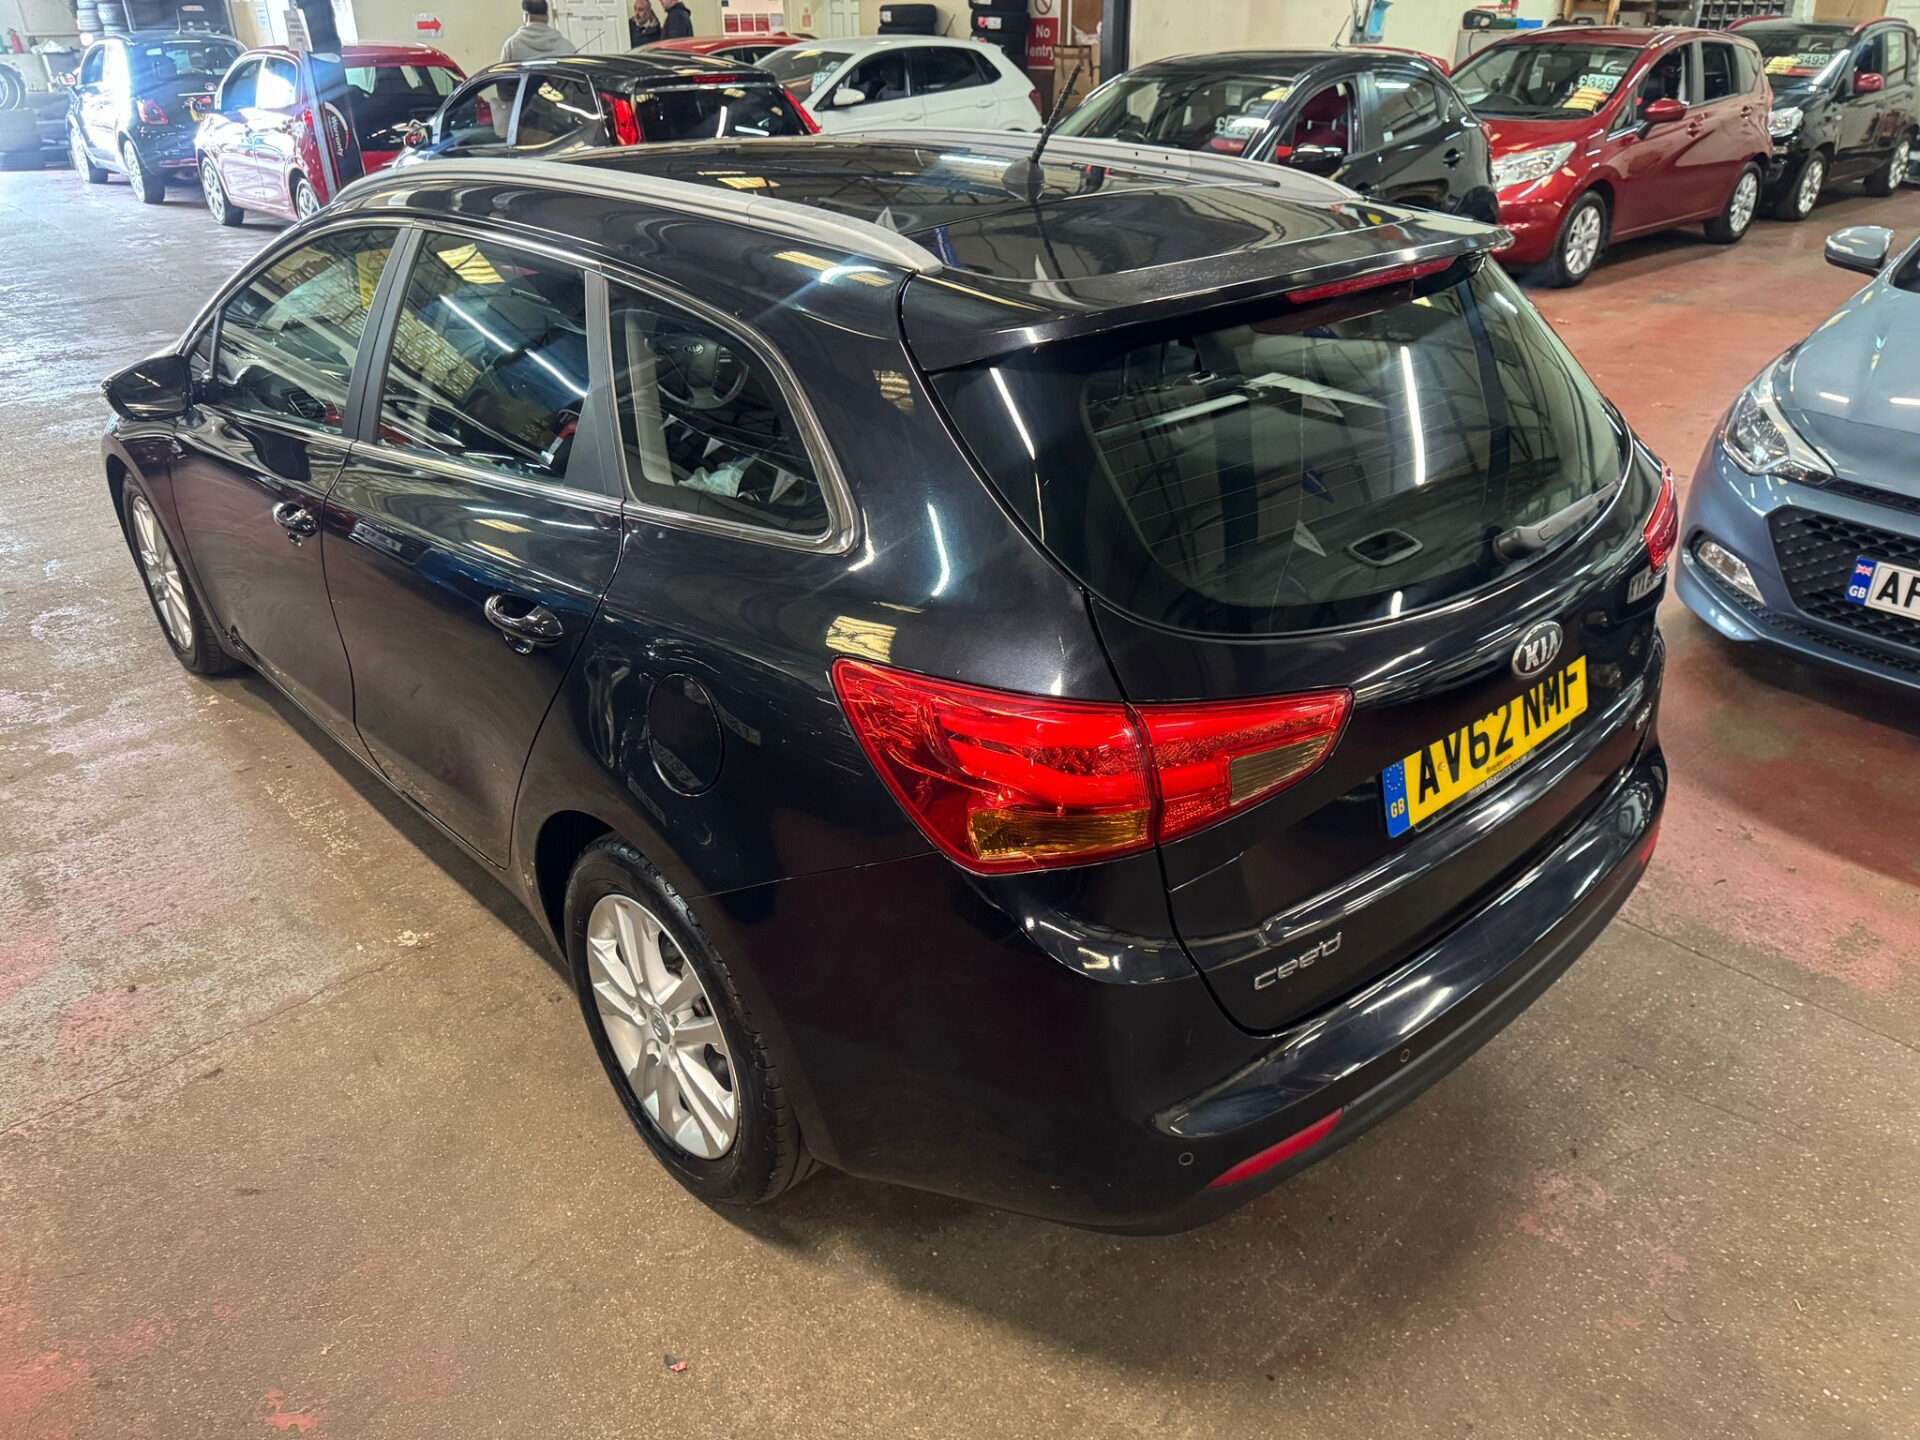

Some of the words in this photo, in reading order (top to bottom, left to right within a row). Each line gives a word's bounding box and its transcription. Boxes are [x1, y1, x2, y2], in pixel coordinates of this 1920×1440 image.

[1036, 24, 1050, 38] No
[1029, 44, 1054, 61] entry
[1849, 585, 1866, 598] GB
[1524, 630, 1558, 671] KIA
[1419, 701, 1514, 804] AV62
[1391, 798, 1405, 818] GB
